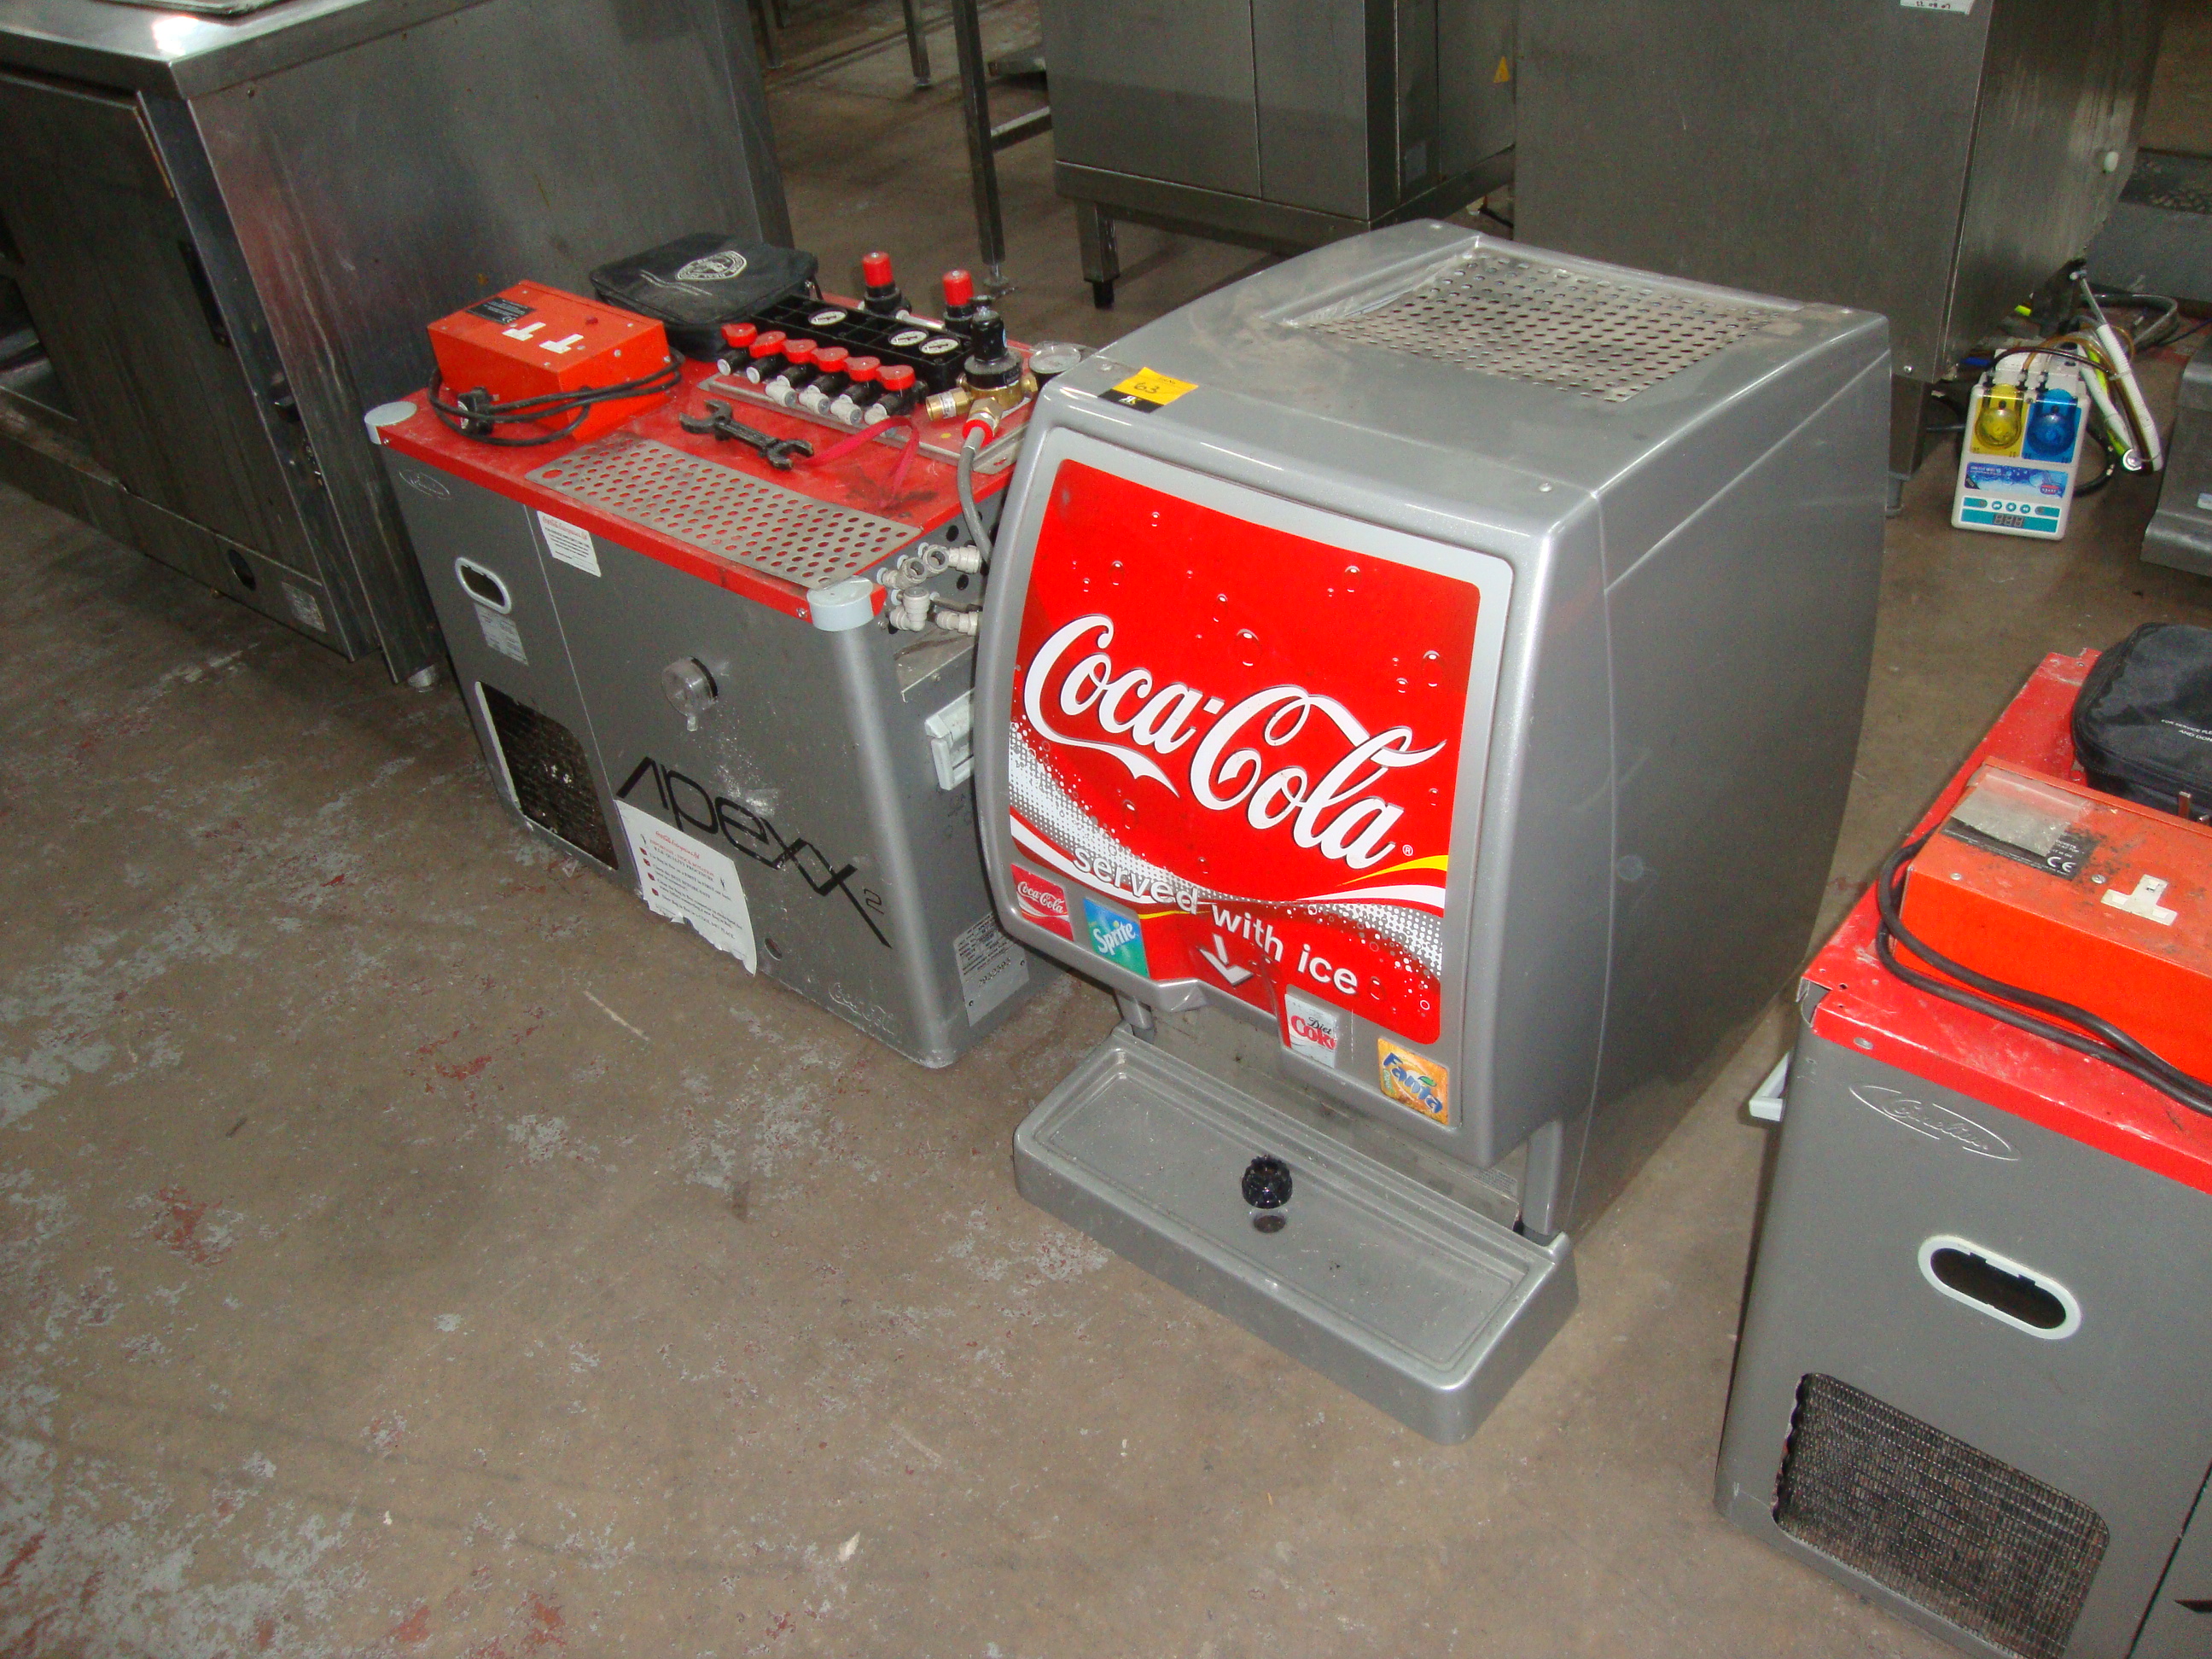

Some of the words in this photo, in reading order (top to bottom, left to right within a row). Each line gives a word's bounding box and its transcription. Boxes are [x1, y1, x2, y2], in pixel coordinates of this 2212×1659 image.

[1024, 614, 1447, 869] Coca-Cola
[1017, 882, 1065, 914] Coca-Cola
[1072, 843, 1199, 916] served
[1211, 904, 1284, 963] with
[1297, 942, 1359, 995] ice
[1092, 922, 1137, 956] Sprite
[1307, 1016, 1332, 1035] Diet
[1382, 1051, 1443, 1114] Fanta
